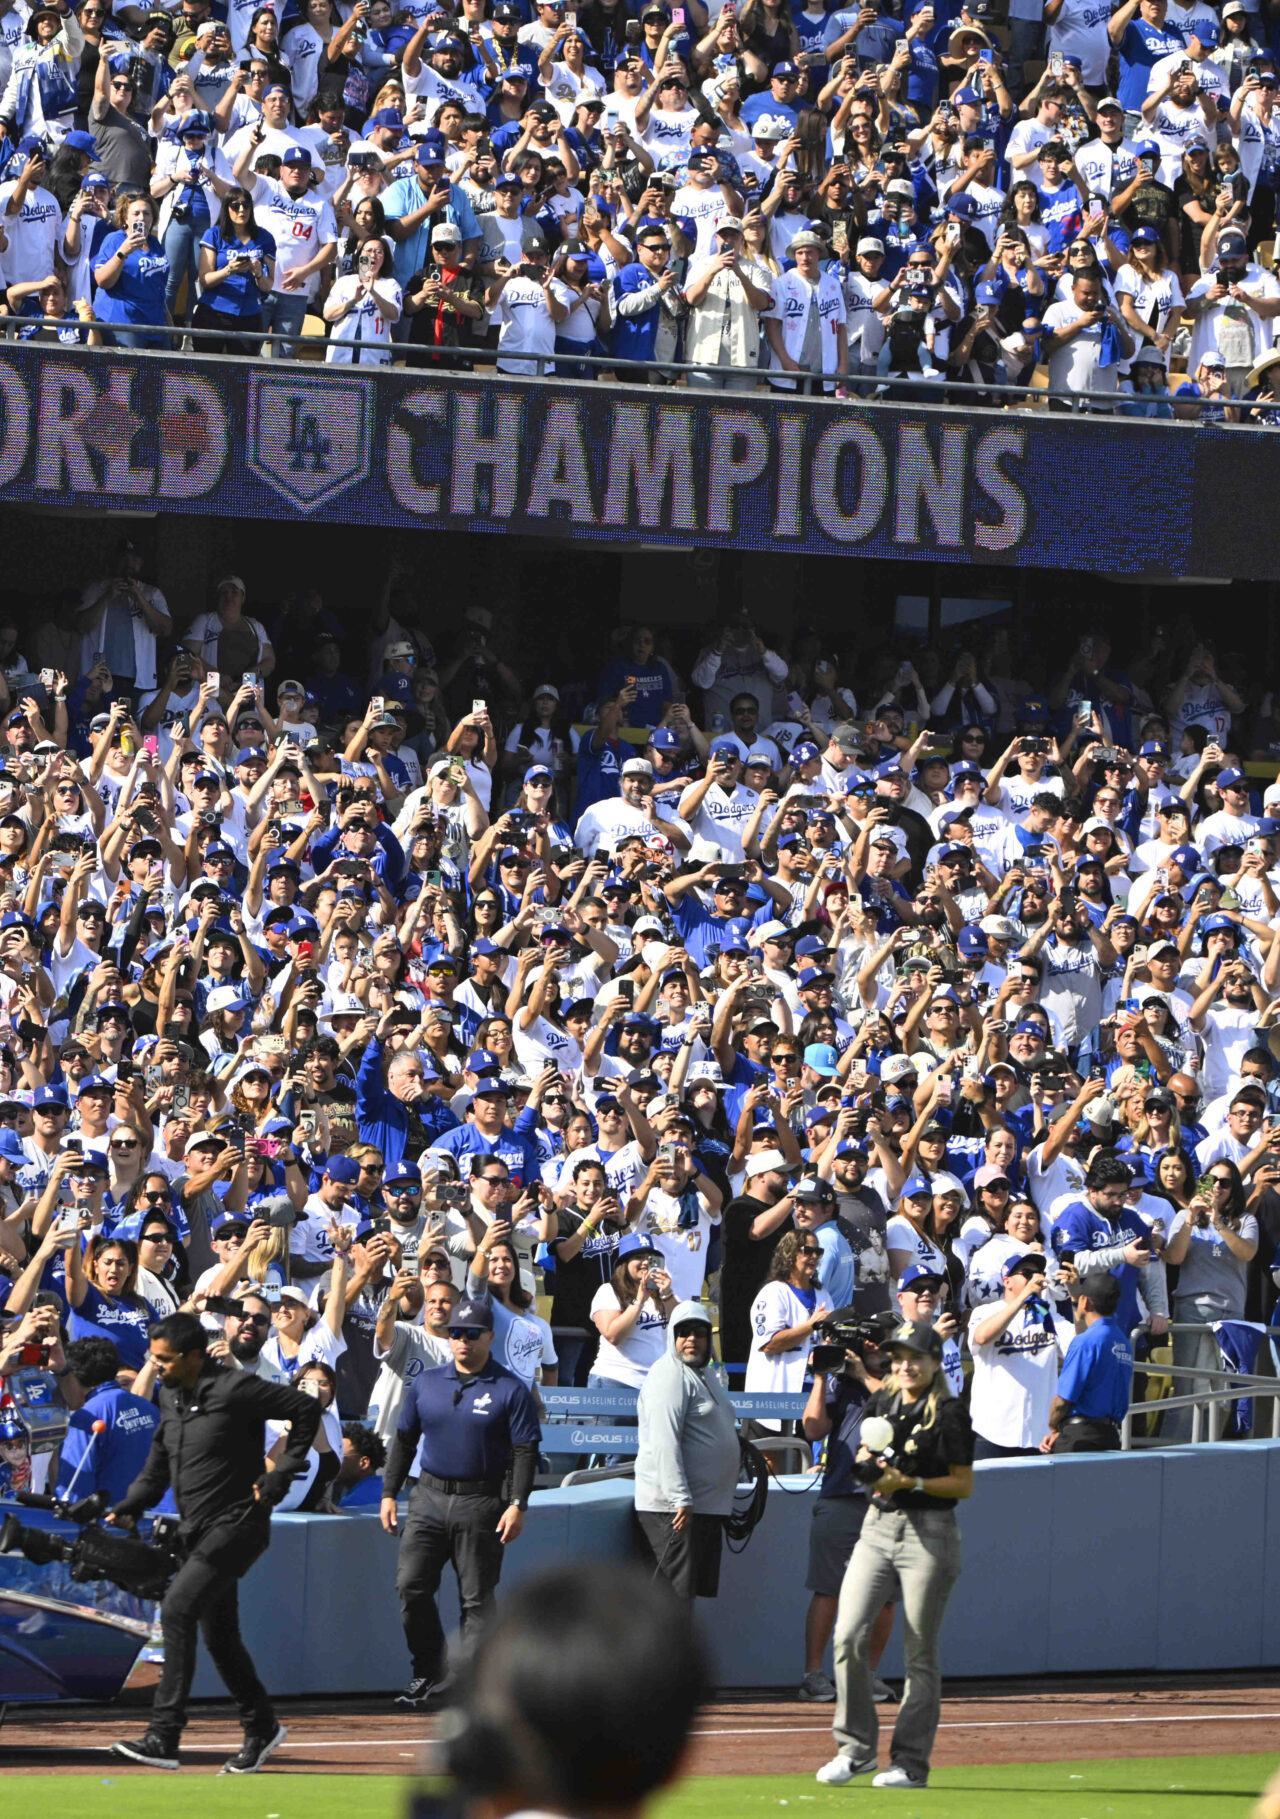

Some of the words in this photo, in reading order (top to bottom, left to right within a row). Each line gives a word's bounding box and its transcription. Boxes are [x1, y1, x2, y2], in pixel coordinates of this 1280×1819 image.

[19, 203, 56, 223] Dodgers
[272, 196, 316, 218] Dodgers
[680, 200, 725, 218] Dodgers
[292, 221, 313, 240] 04
[508, 290, 546, 310] Dodge
[386, 386, 1029, 551] CHAMPIONS
[709, 800, 757, 824] Dodgers
[972, 819, 999, 838] dgers
[1091, 1228, 1136, 1248] Dodgers
[542, 1396, 580, 1405] LEXUS
[582, 1397, 617, 1406] BASELINE
[755, 1401, 788, 1410] BASELINE
[791, 1402, 807, 1410] CLU
[585, 1434, 622, 1443] LEXUS
